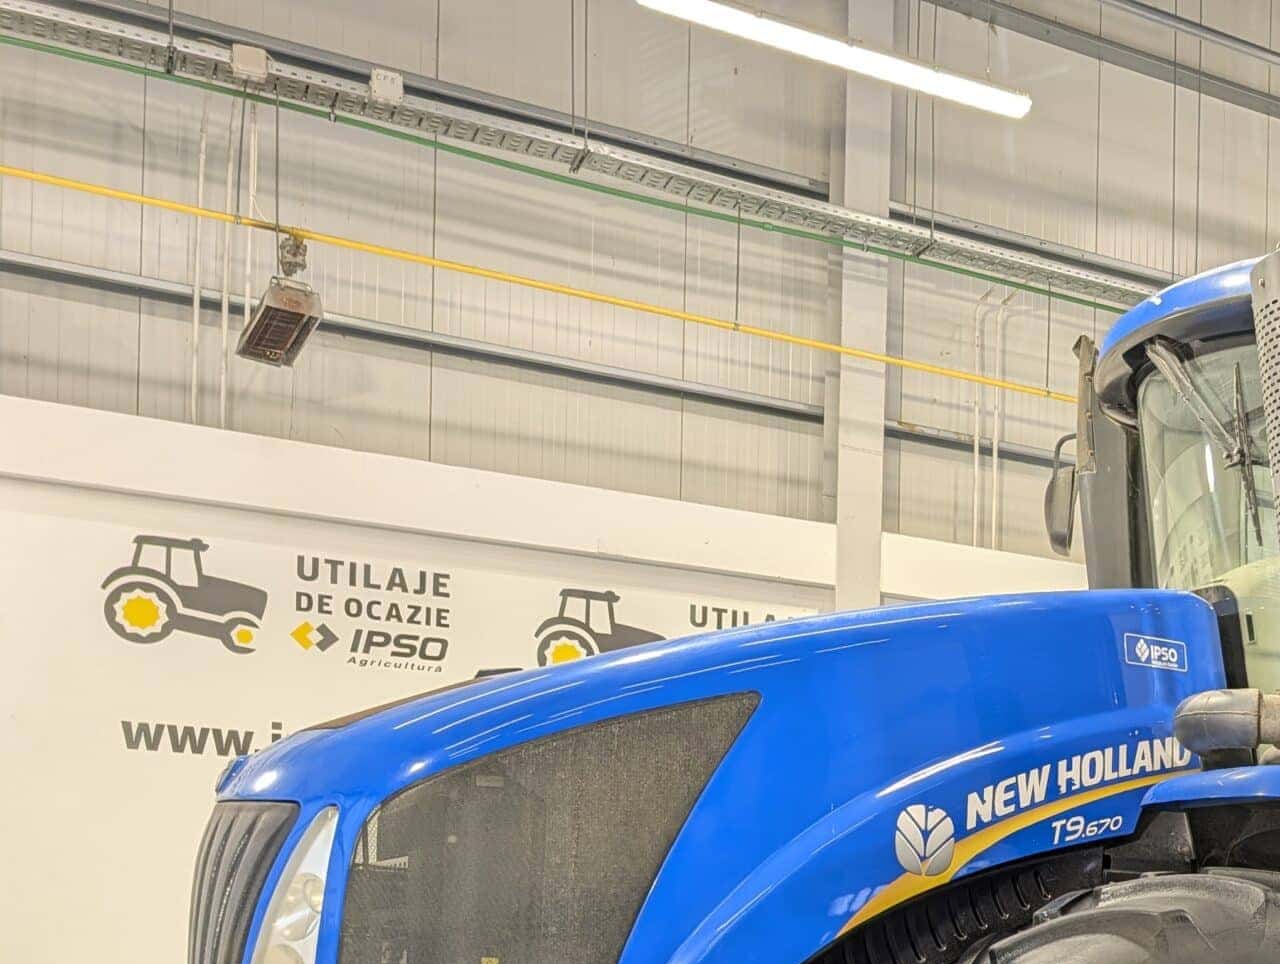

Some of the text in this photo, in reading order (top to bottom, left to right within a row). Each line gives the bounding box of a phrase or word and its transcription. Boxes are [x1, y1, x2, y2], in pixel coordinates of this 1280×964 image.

[297, 555, 450, 598] UTILAJE
[295, 591, 450, 628] DE OCAZIE
[350, 629, 449, 662] IPSO
[1150, 645, 1178, 662] IPSO
[966, 737, 1192, 830] NEW HOLLAND
[1051, 816, 1123, 845] T9.670
